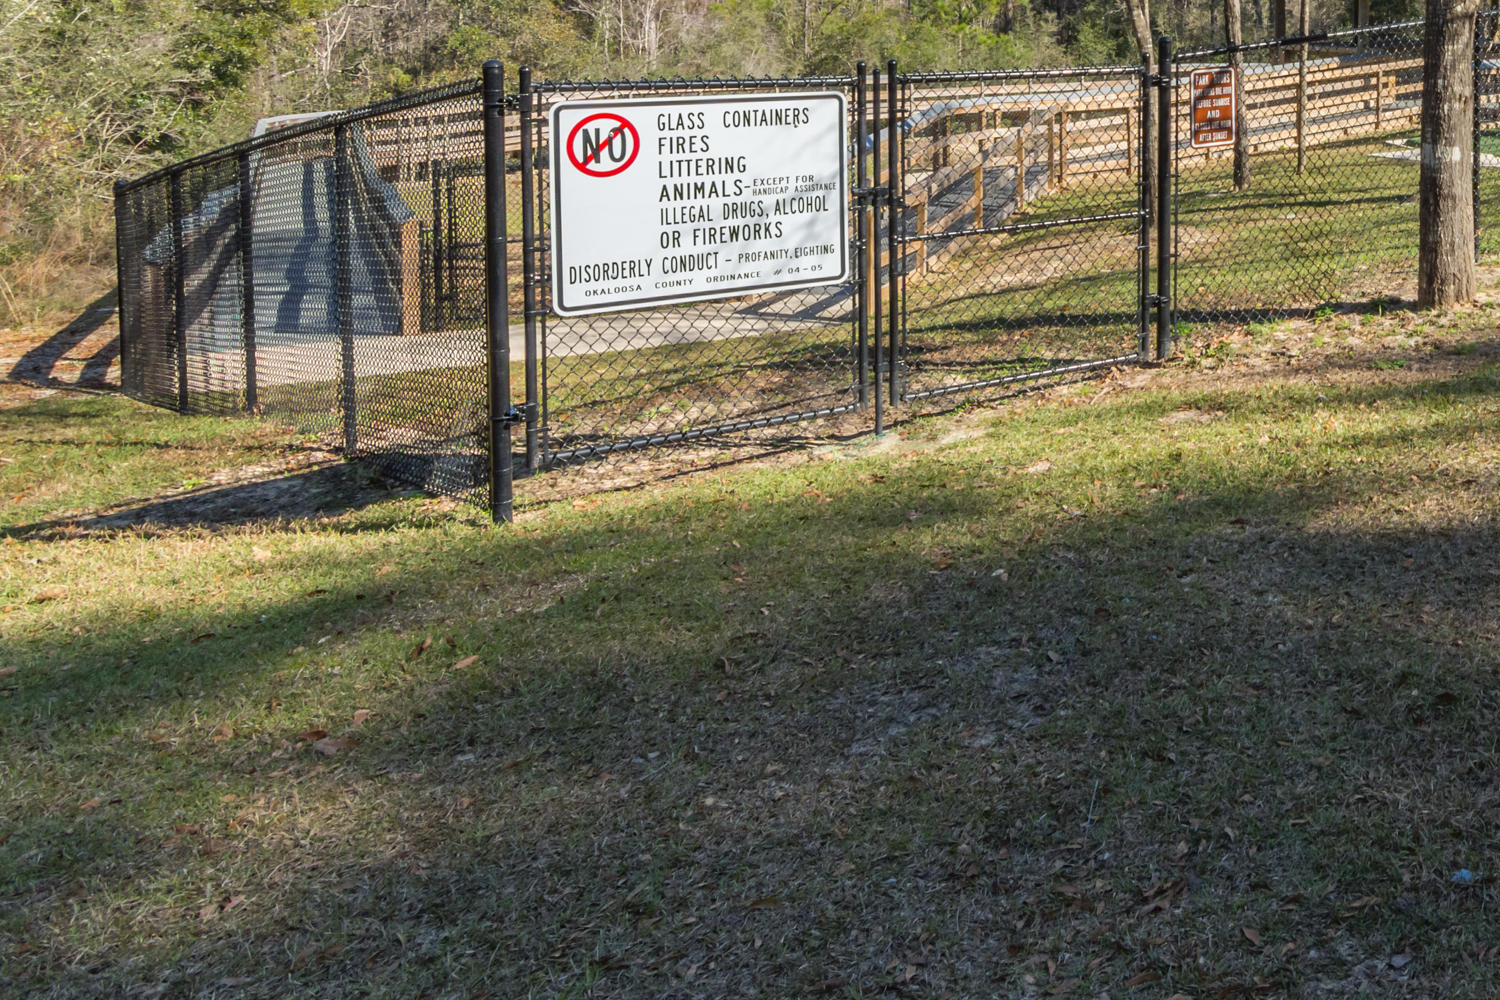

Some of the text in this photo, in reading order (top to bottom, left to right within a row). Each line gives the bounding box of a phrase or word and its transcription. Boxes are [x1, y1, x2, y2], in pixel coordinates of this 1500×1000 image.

[1195, 74, 1209, 86] PARK
[658, 108, 809, 131] GLASS CONTAINERS
[1206, 110, 1220, 119] AND
[582, 127, 627, 164] NO
[659, 135, 710, 155] FIRES
[659, 156, 746, 178] LITTERING
[753, 177, 789, 188] EXCEPT
[796, 175, 814, 185] FOR
[753, 183, 836, 196] HANDICAP ASSISTANCE
[661, 196, 828, 226] ILLEGAL DRUGS, ALCOHOL
[661, 222, 782, 248] OR FIREWORKS
[569, 258, 652, 284] DISORDERLY
[663, 252, 719, 275] CONDUCT
[585, 284, 642, 297] OKALOOSA
[655, 278, 693, 289] COUNTY
[706, 271, 761, 284] ORDINANCE
